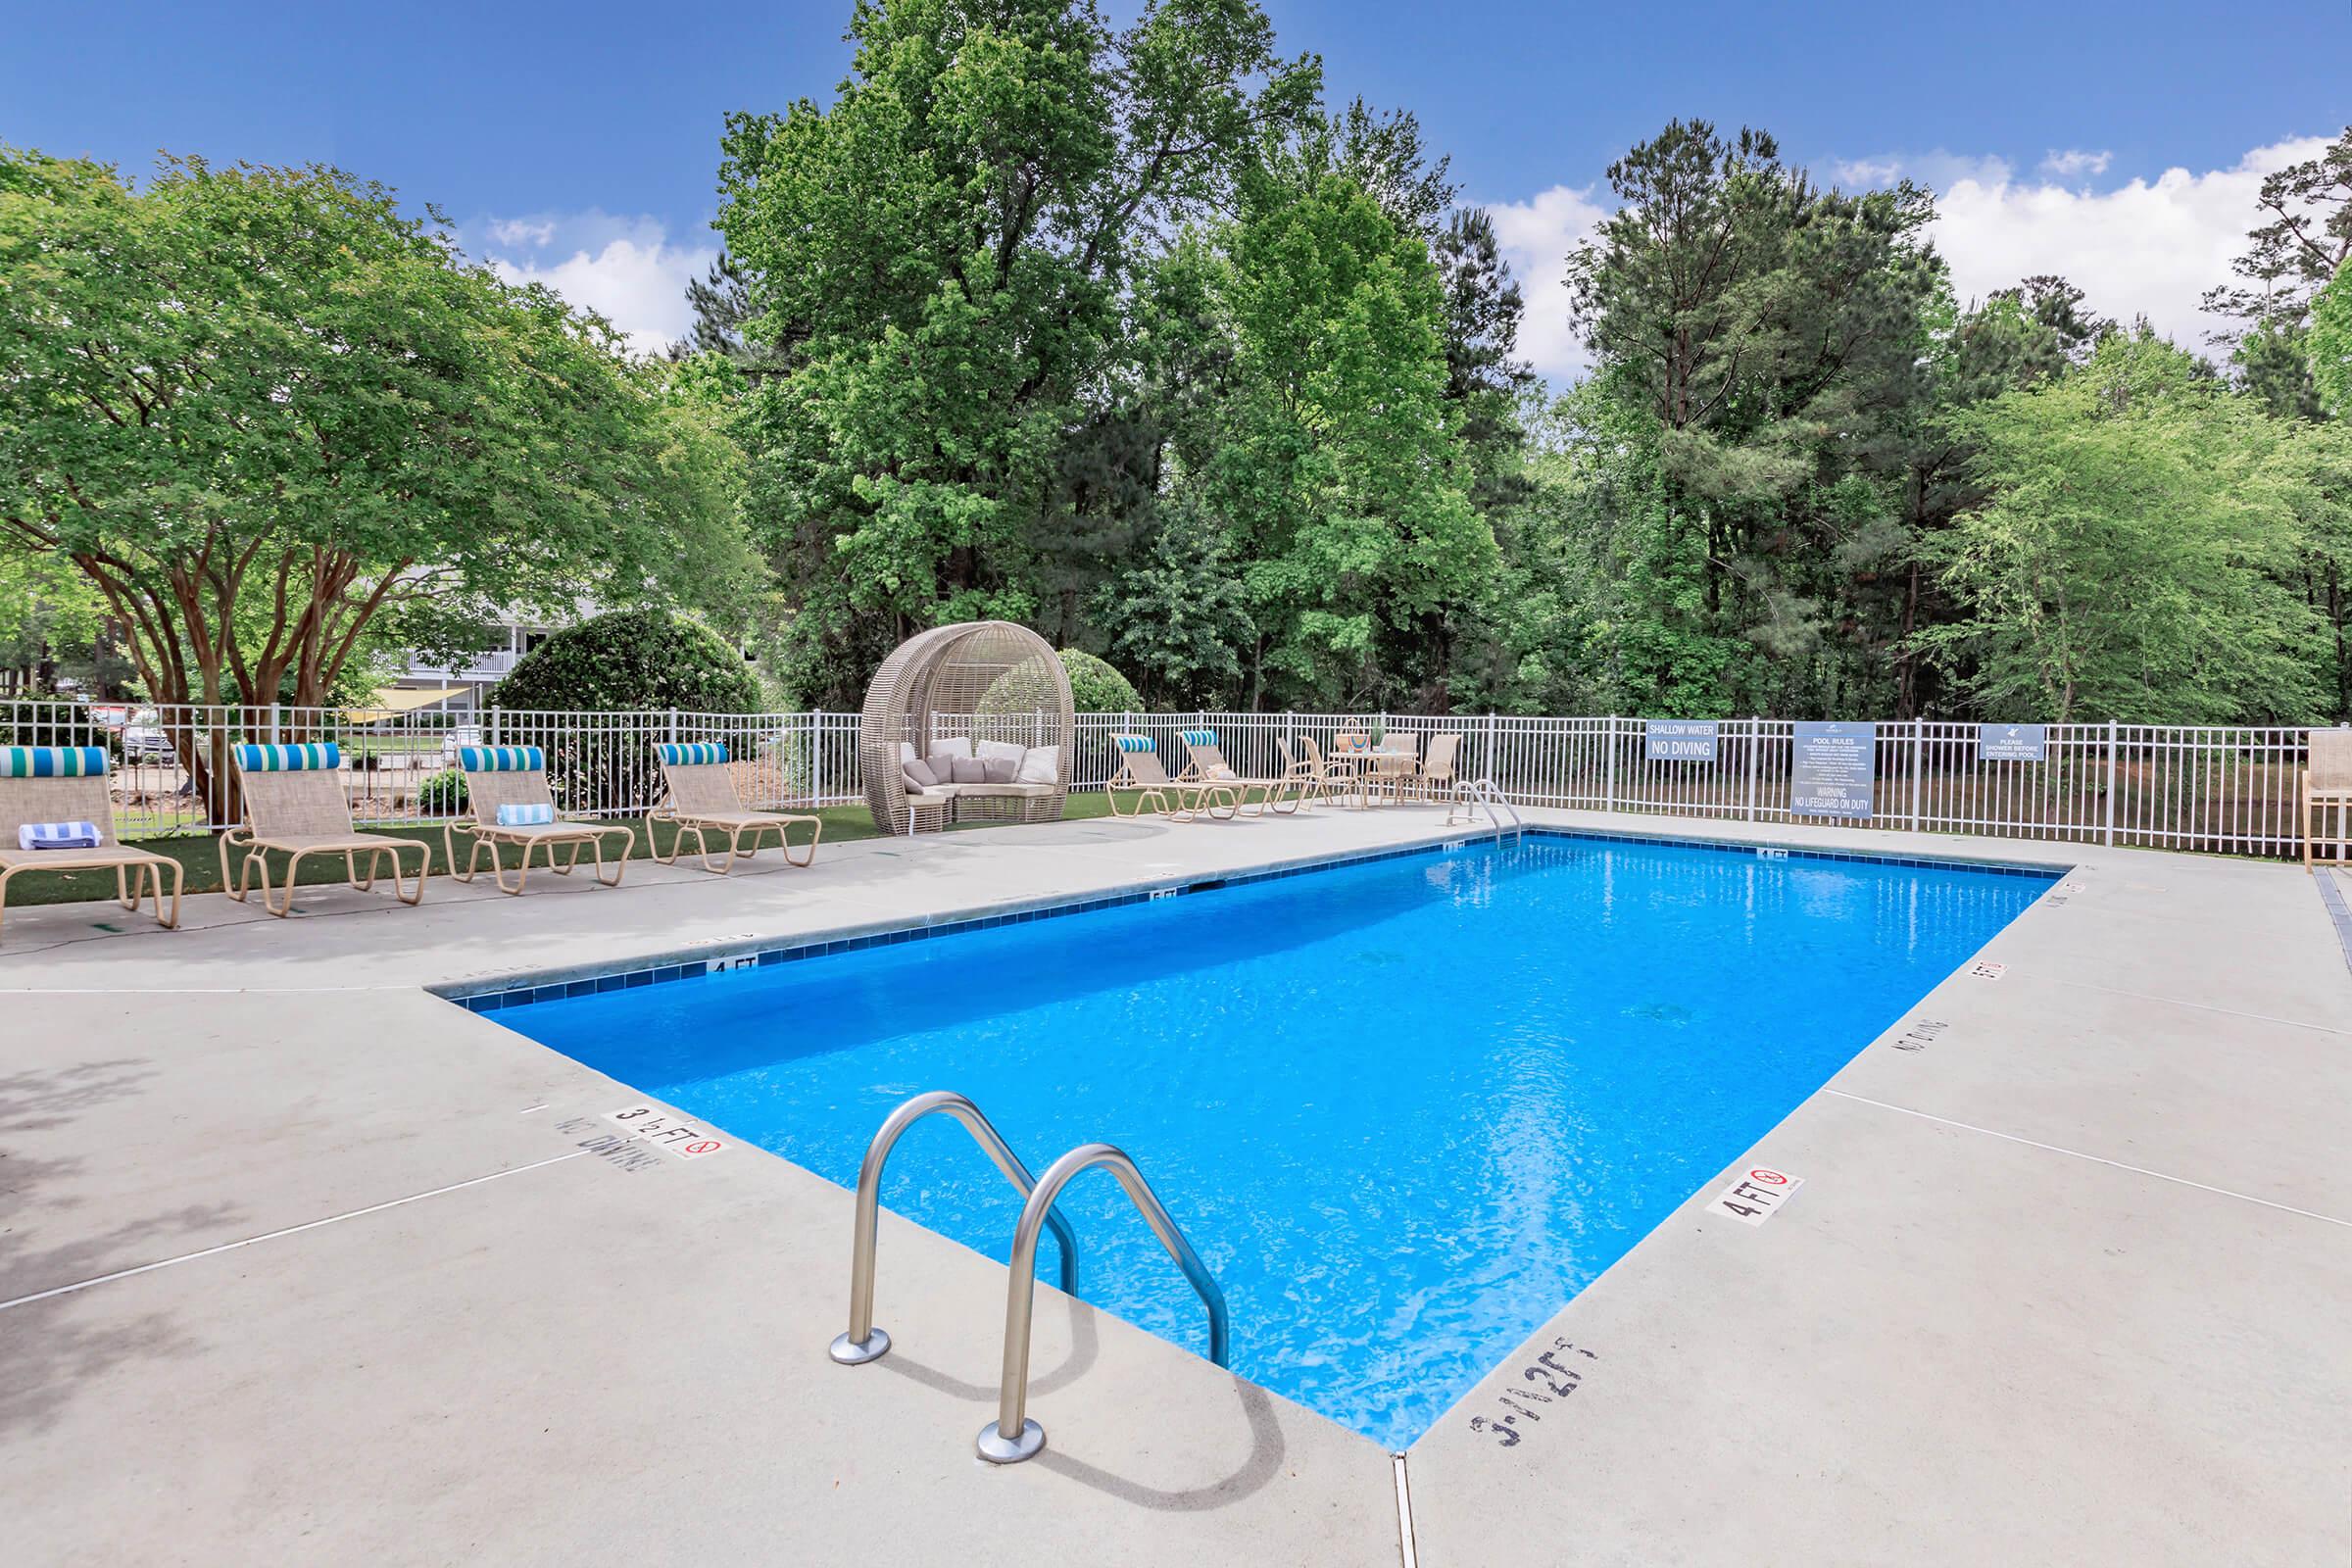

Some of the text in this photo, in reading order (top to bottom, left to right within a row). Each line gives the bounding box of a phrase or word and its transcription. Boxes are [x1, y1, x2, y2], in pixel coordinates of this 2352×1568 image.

[1649, 725, 1713, 735] SHALLOW WATER
[1652, 741, 1710, 756] NO DIVING
[1817, 787, 1847, 798] WARNING
[1795, 797, 1869, 809] NO LIFEGUARD ON DUTY
[714, 957, 756, 972] 4 FT
[615, 1107, 650, 1120] 3
[652, 1127, 700, 1145] FT
[1723, 1181, 1780, 1216] 4 FT
